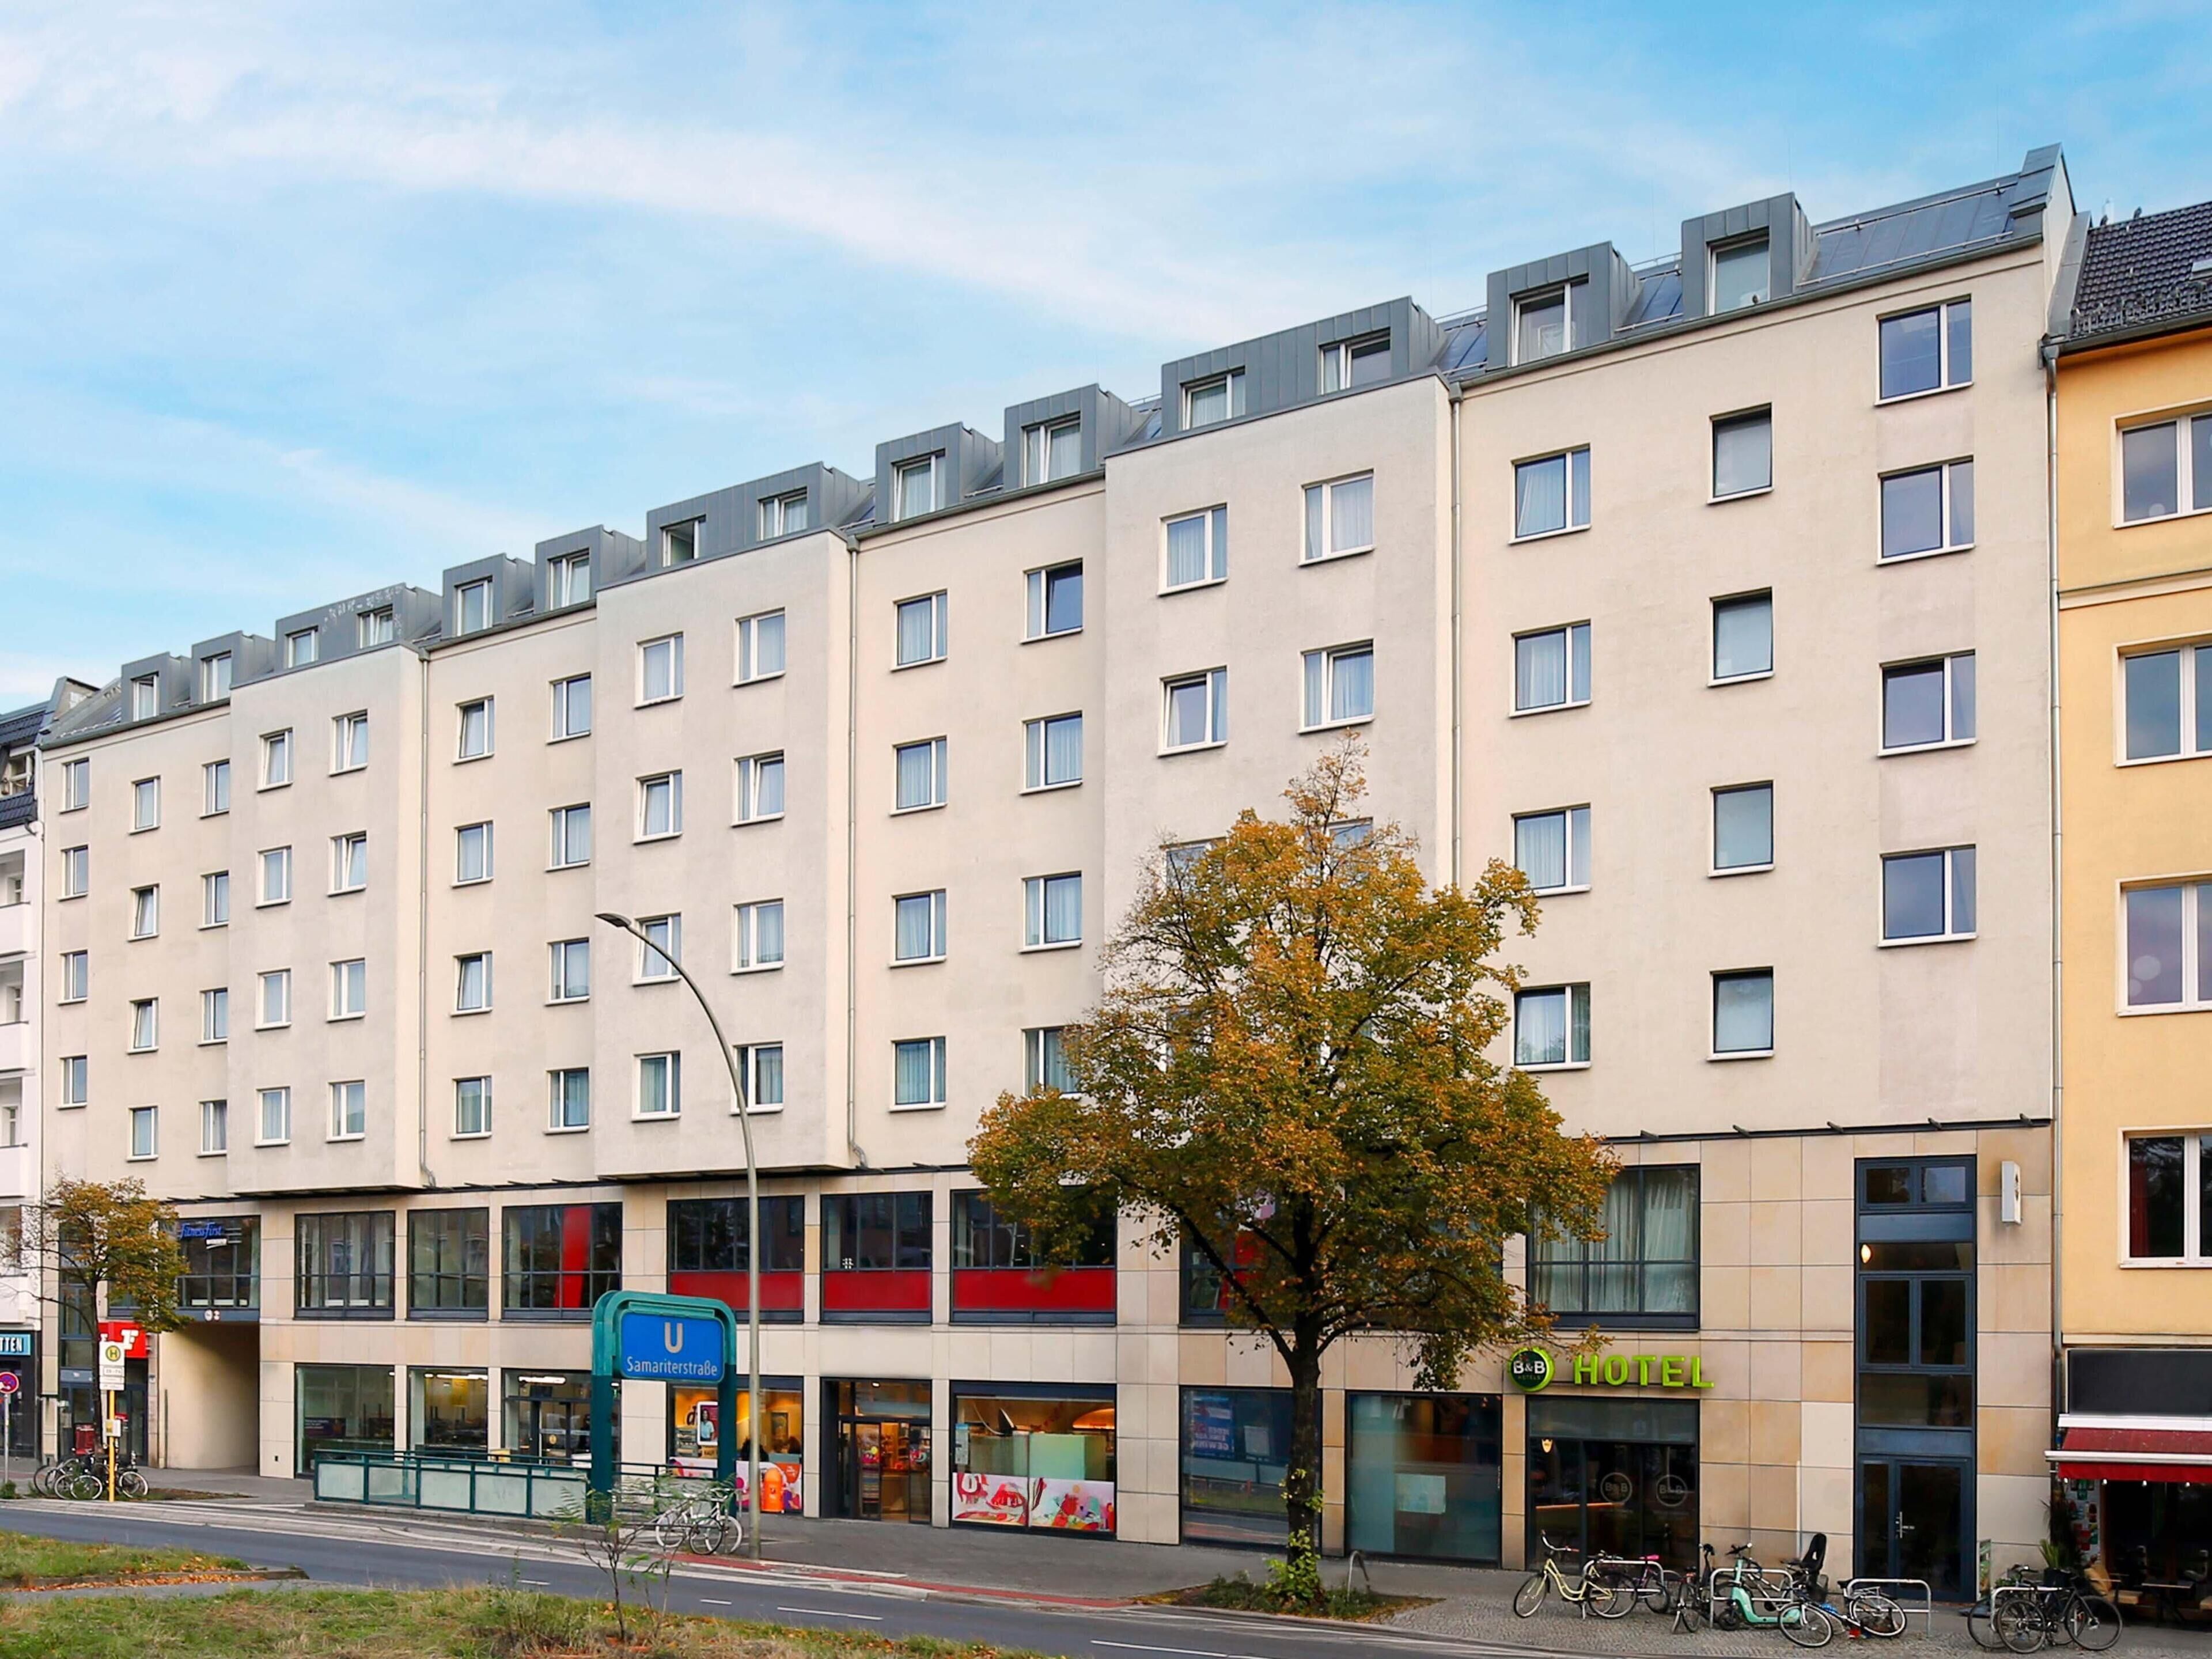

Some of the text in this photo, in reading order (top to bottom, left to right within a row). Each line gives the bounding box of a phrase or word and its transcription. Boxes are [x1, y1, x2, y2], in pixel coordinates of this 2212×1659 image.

[664, 1322, 683, 1353] U
[627, 1356, 718, 1376] Samariterstraße
[1513, 1360, 1546, 1374] B&B
[1574, 1354, 1714, 1388] HOTEL
